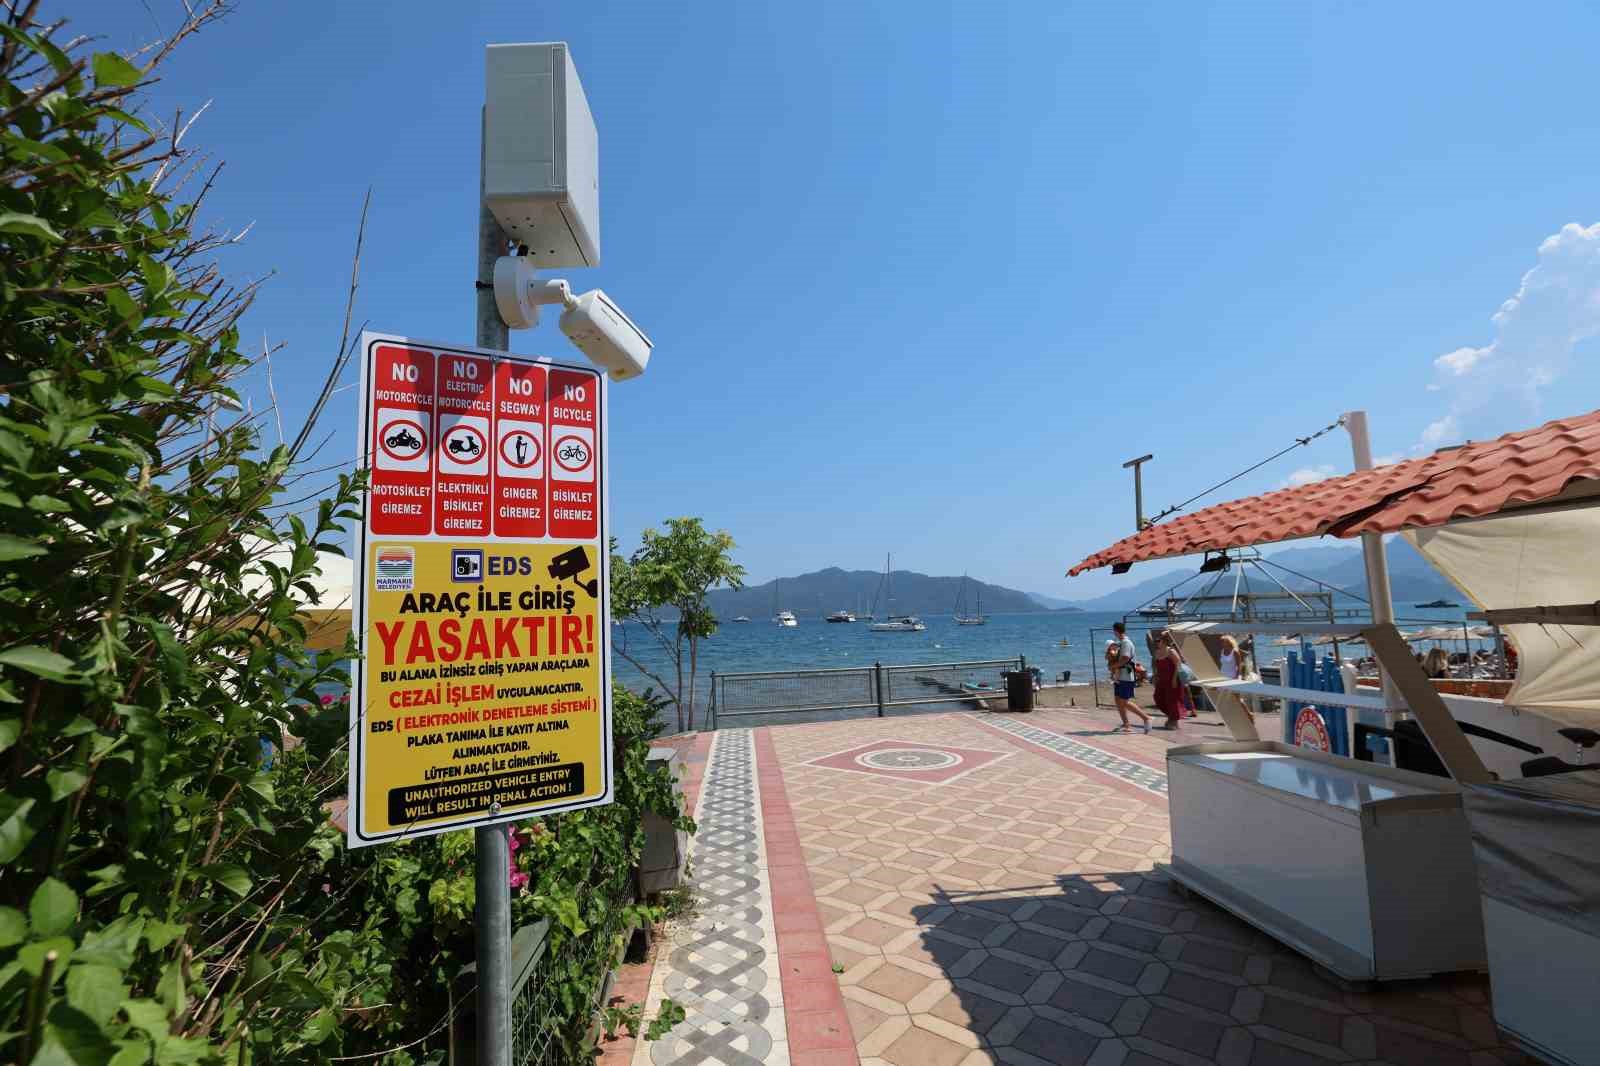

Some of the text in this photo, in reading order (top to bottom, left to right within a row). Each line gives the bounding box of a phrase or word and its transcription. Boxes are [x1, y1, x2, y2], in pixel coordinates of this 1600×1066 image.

[392, 363, 418, 382] NO
[454, 361, 477, 379] NO
[447, 380, 484, 393] ELECTRIC
[509, 378, 532, 396] NO
[564, 385, 585, 402] NO
[376, 390, 432, 405] MOTORCYCLE
[439, 397, 491, 411] MOTORCYCLE
[500, 401, 540, 416] SEGWAY
[554, 407, 591, 421] BICYCLE
[374, 484, 430, 496] MOTOSİKLET
[503, 488, 538, 500] GINGER
[553, 489, 592, 503] BİSİKLET
[382, 501, 422, 514] GİREMEZ
[444, 499, 483, 511] BİSİKLET
[500, 505, 540, 518] GİREMEZ
[554, 507, 592, 520] GİREMEZ
[444, 517, 482, 529] GİREMEZ
[488, 556, 532, 576] EDS
[400, 584, 575, 617] ARAÇ İLE GİRİŞ
[376, 615, 594, 665] YASAKTIR!
[381, 659, 590, 682] BU ALANA İZİNSİZ GİRİŞ YAPAN ARAÇLARA
[389, 682, 583, 708] CEZAİ İŞLEM UYGULANACAKTIR.
[371, 720, 393, 732] EDS
[404, 708, 479, 729] ELEKTRONİK
[483, 703, 547, 720] DENETLEME
[551, 696, 590, 713] SİSTEMİ
[408, 720, 569, 747] PLAKA TANIMA İLE KAYIT ALTINA
[453, 741, 530, 759] ALINMAKTADIR.
[425, 751, 560, 780] LÜTFEN ARAÇ İLE GİRMEYİNİZ.
[405, 769, 570, 802] UNAUTHORIZED VEHICLE ENTRY
[405, 807, 434, 818] WILL
[437, 798, 476, 812] RESULT
[480, 795, 490, 806] IN
[494, 790, 527, 803] PENAL
[530, 784, 566, 798] ACTION
